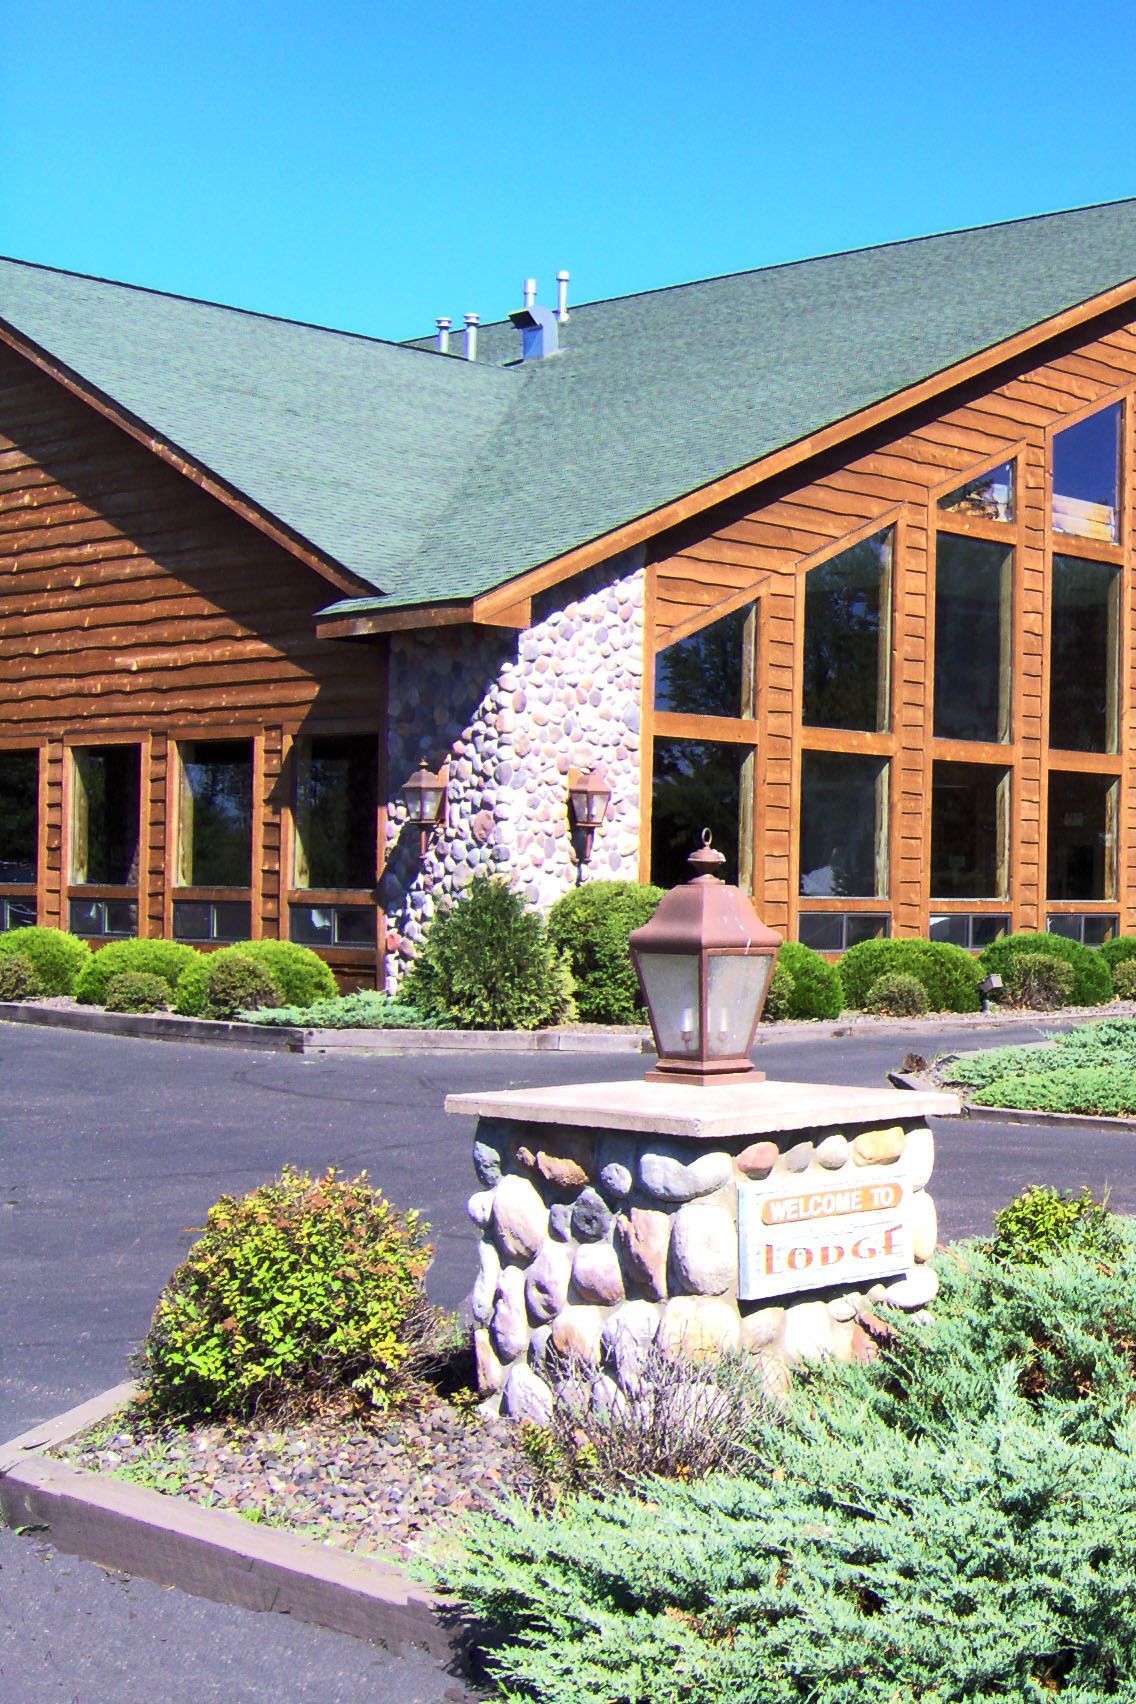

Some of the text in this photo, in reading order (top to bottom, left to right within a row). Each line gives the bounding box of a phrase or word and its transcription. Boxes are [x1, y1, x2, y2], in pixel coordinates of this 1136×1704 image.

[770, 1187, 895, 1221] WELCOME TO
[764, 1224, 903, 1276] LODGE
